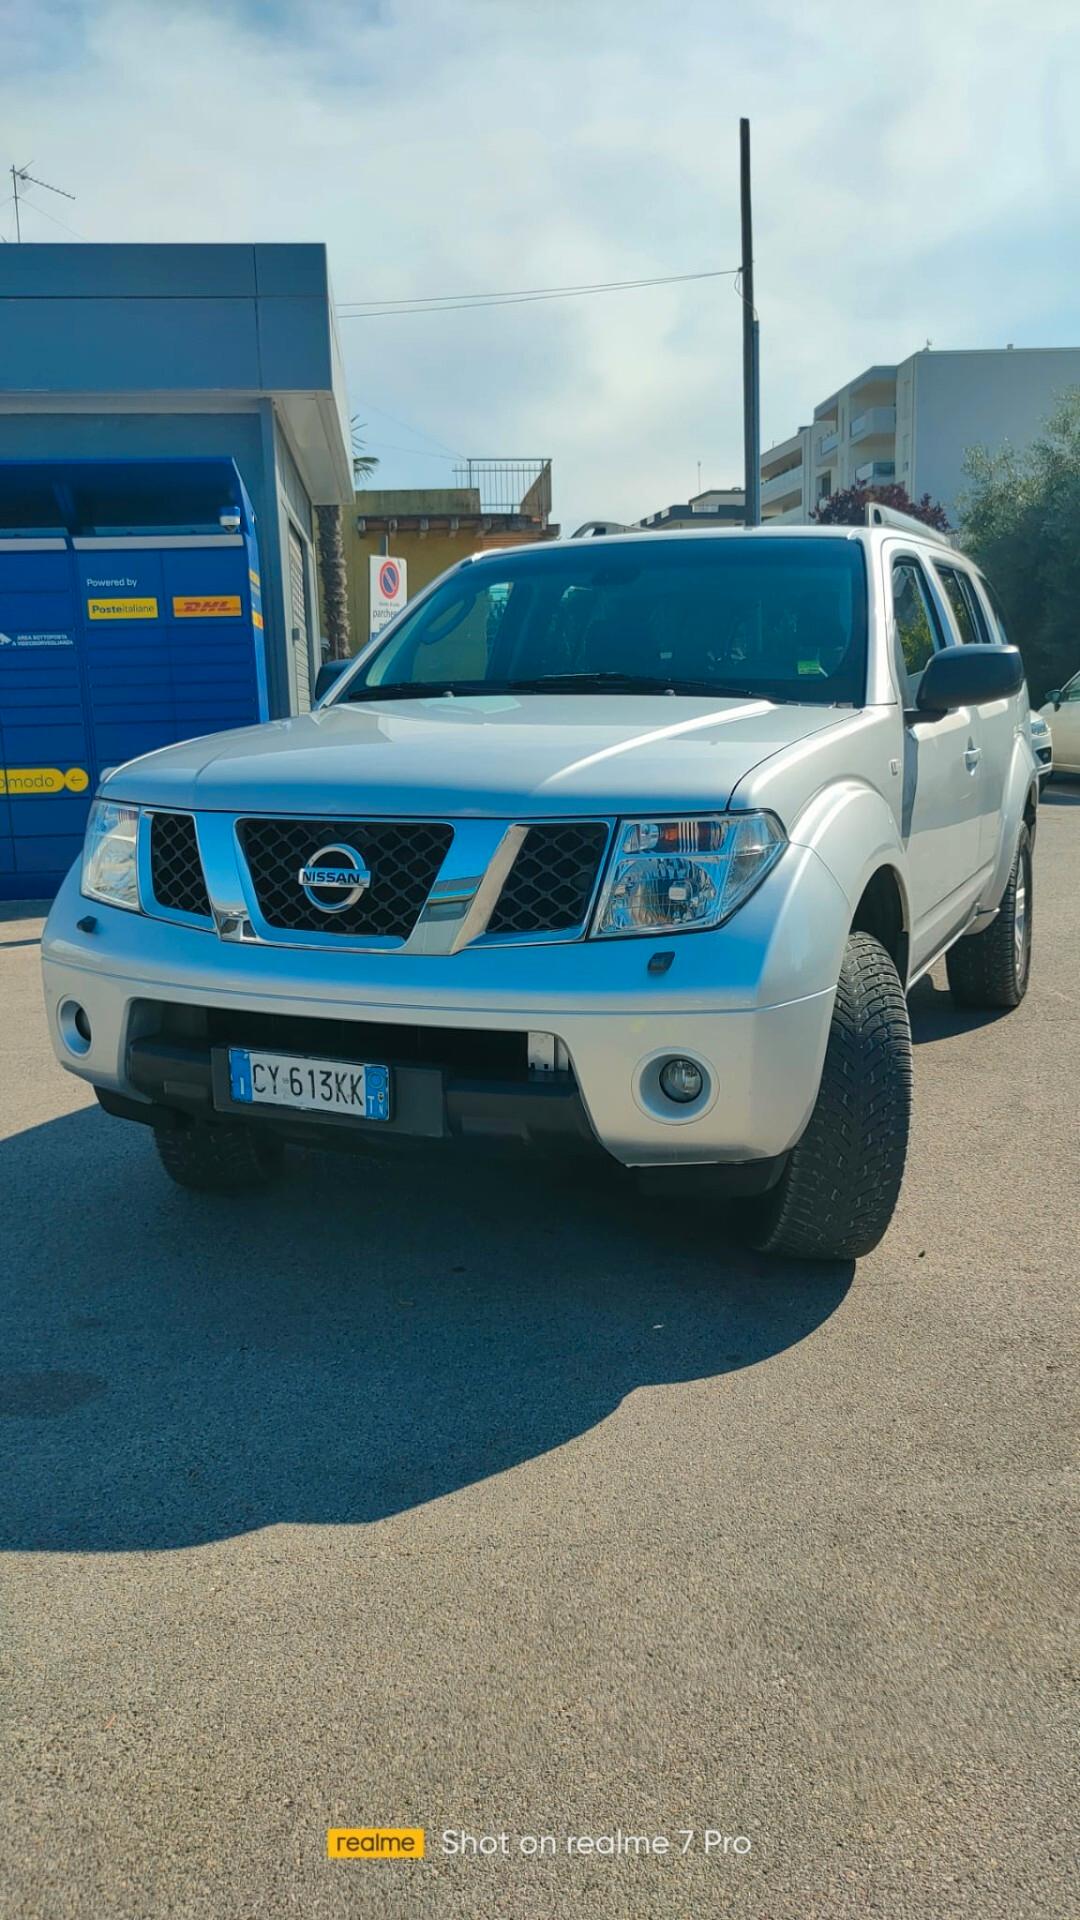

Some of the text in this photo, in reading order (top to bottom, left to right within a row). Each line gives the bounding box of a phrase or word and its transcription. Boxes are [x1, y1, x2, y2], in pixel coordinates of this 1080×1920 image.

[86, 578, 137, 588] Powered by
[183, 600, 232, 612] DHL
[303, 871, 360, 884] NISSAN
